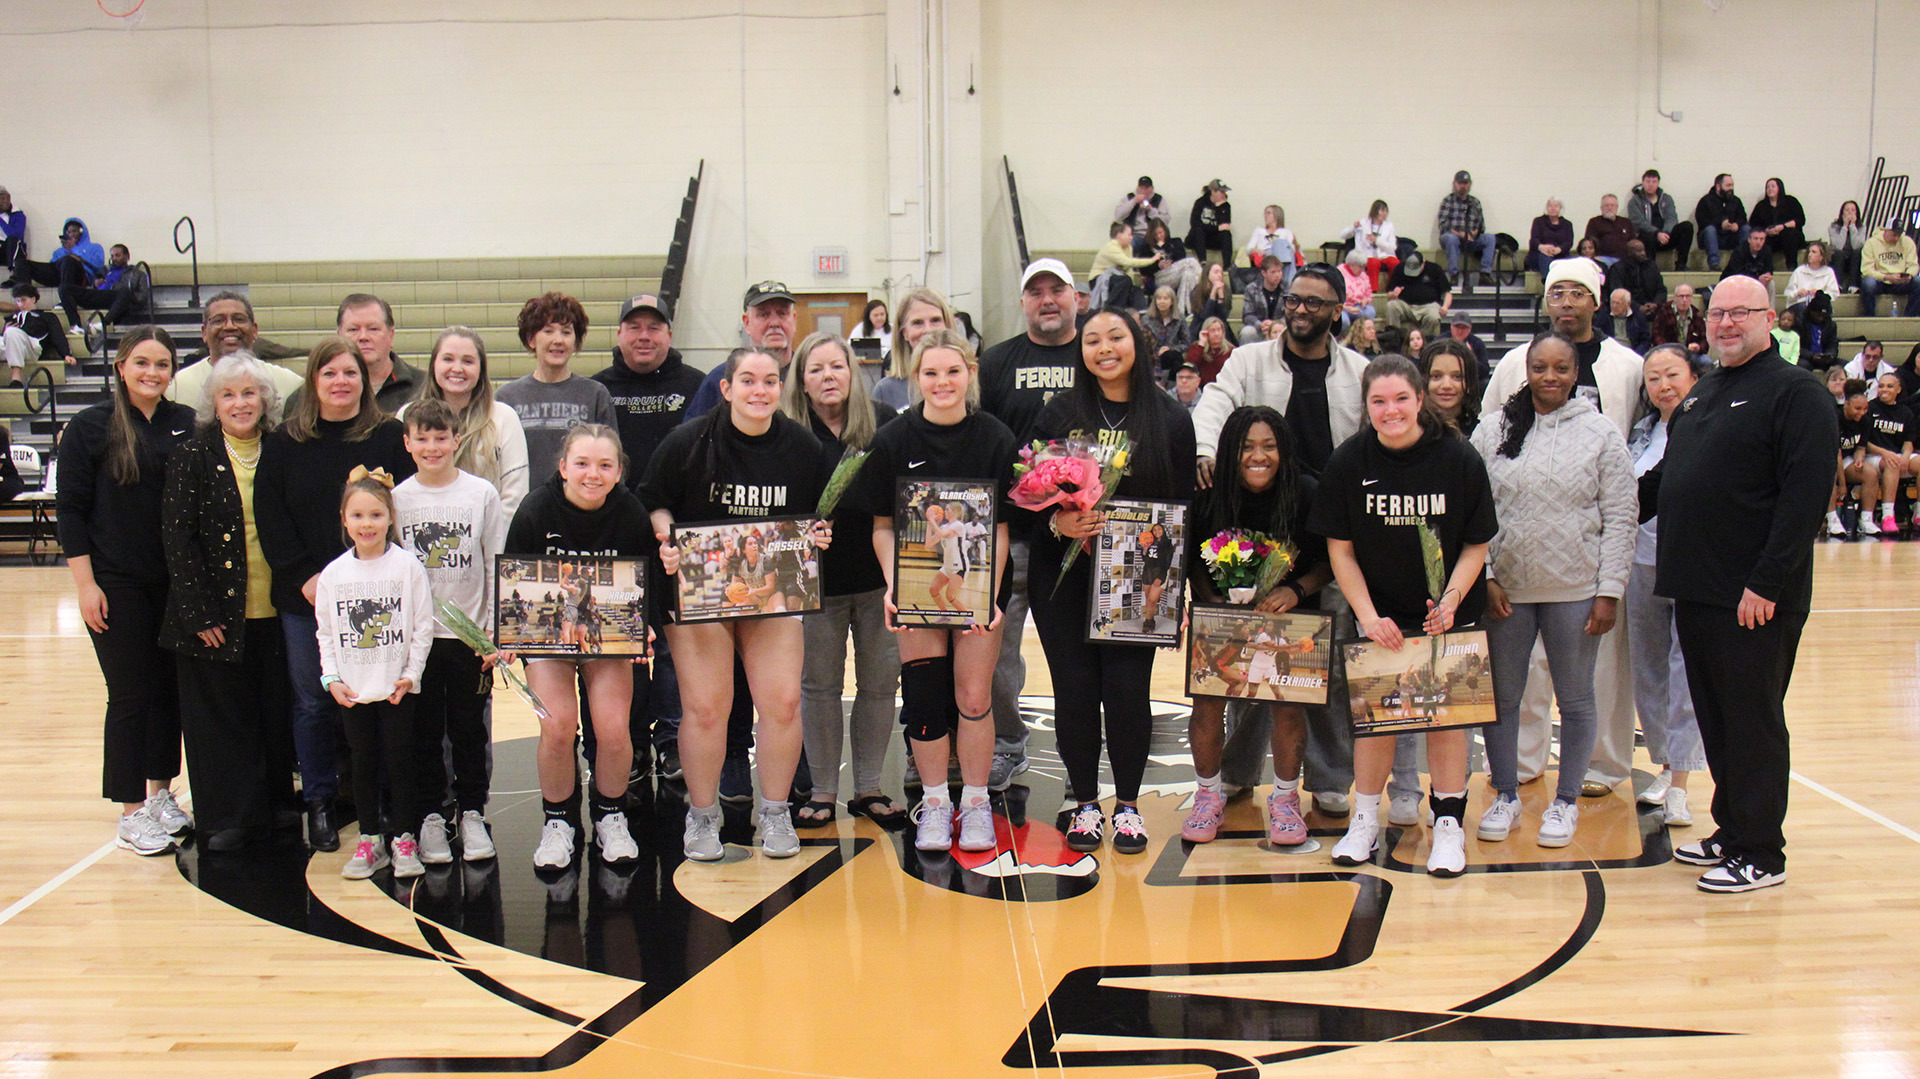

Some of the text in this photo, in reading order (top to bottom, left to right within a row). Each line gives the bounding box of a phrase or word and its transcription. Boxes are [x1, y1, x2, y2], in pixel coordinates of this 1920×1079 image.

[818, 255, 841, 271] EXIT
[1015, 366, 1076, 390] FERRU
[514, 402, 589, 421] PANTHERS
[12, 450, 33, 462] RUM
[728, 504, 770, 517] PANTHERS
[1366, 493, 1447, 516] FERRUM
[767, 539, 810, 553] CASSELL
[335, 580, 404, 601] FERRUM
[607, 590, 641, 601] HARDEN
[1268, 674, 1323, 689] ALEXANDER
